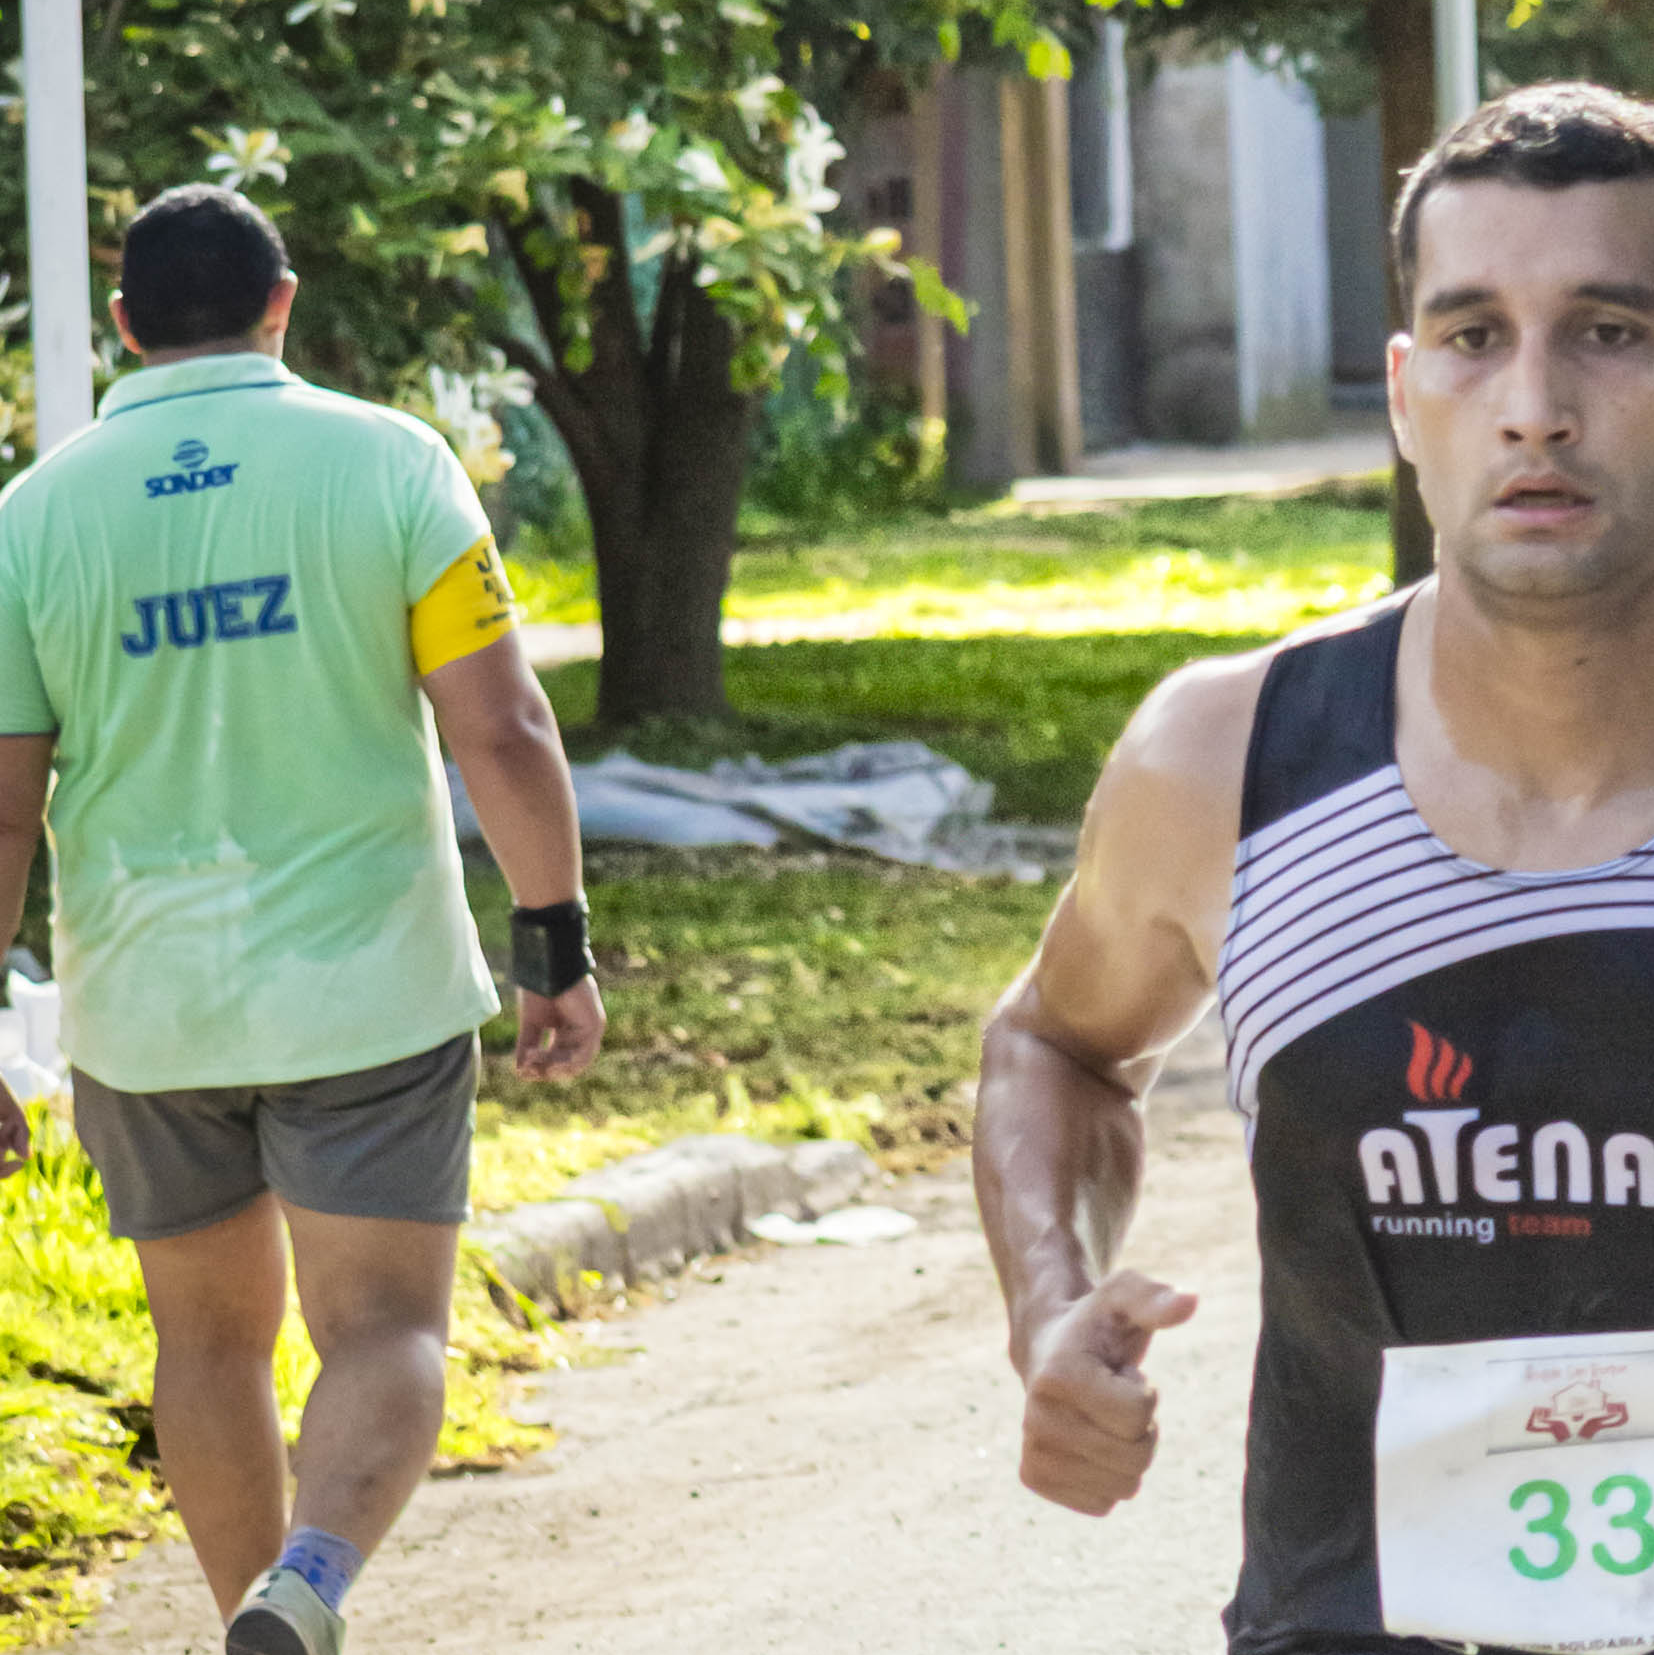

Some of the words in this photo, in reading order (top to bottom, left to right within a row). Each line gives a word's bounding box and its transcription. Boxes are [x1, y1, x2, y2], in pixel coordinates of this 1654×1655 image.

[121, 574, 298, 659] JUEZ
[1371, 1212, 1496, 1244] running
[1507, 1214, 1593, 1239] team
